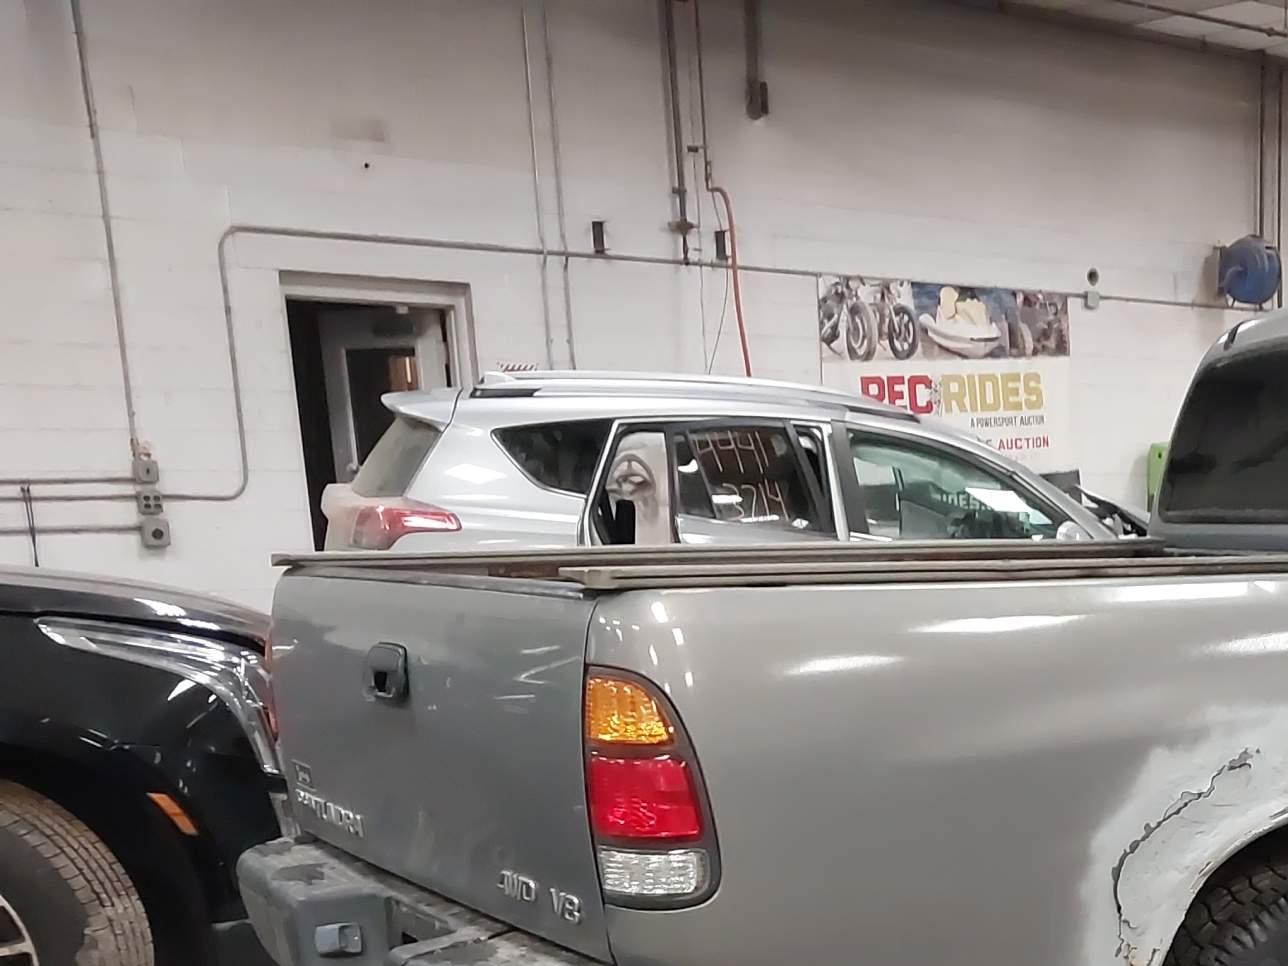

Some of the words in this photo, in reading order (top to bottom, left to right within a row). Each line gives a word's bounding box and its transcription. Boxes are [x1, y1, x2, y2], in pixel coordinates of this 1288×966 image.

[941, 371, 1044, 414] RIDES
[977, 415, 1017, 428] POWERSPORT
[1019, 414, 1045, 427] AUCTION
[997, 435, 1049, 450] AUCTION
[549, 887, 582, 924] V8
